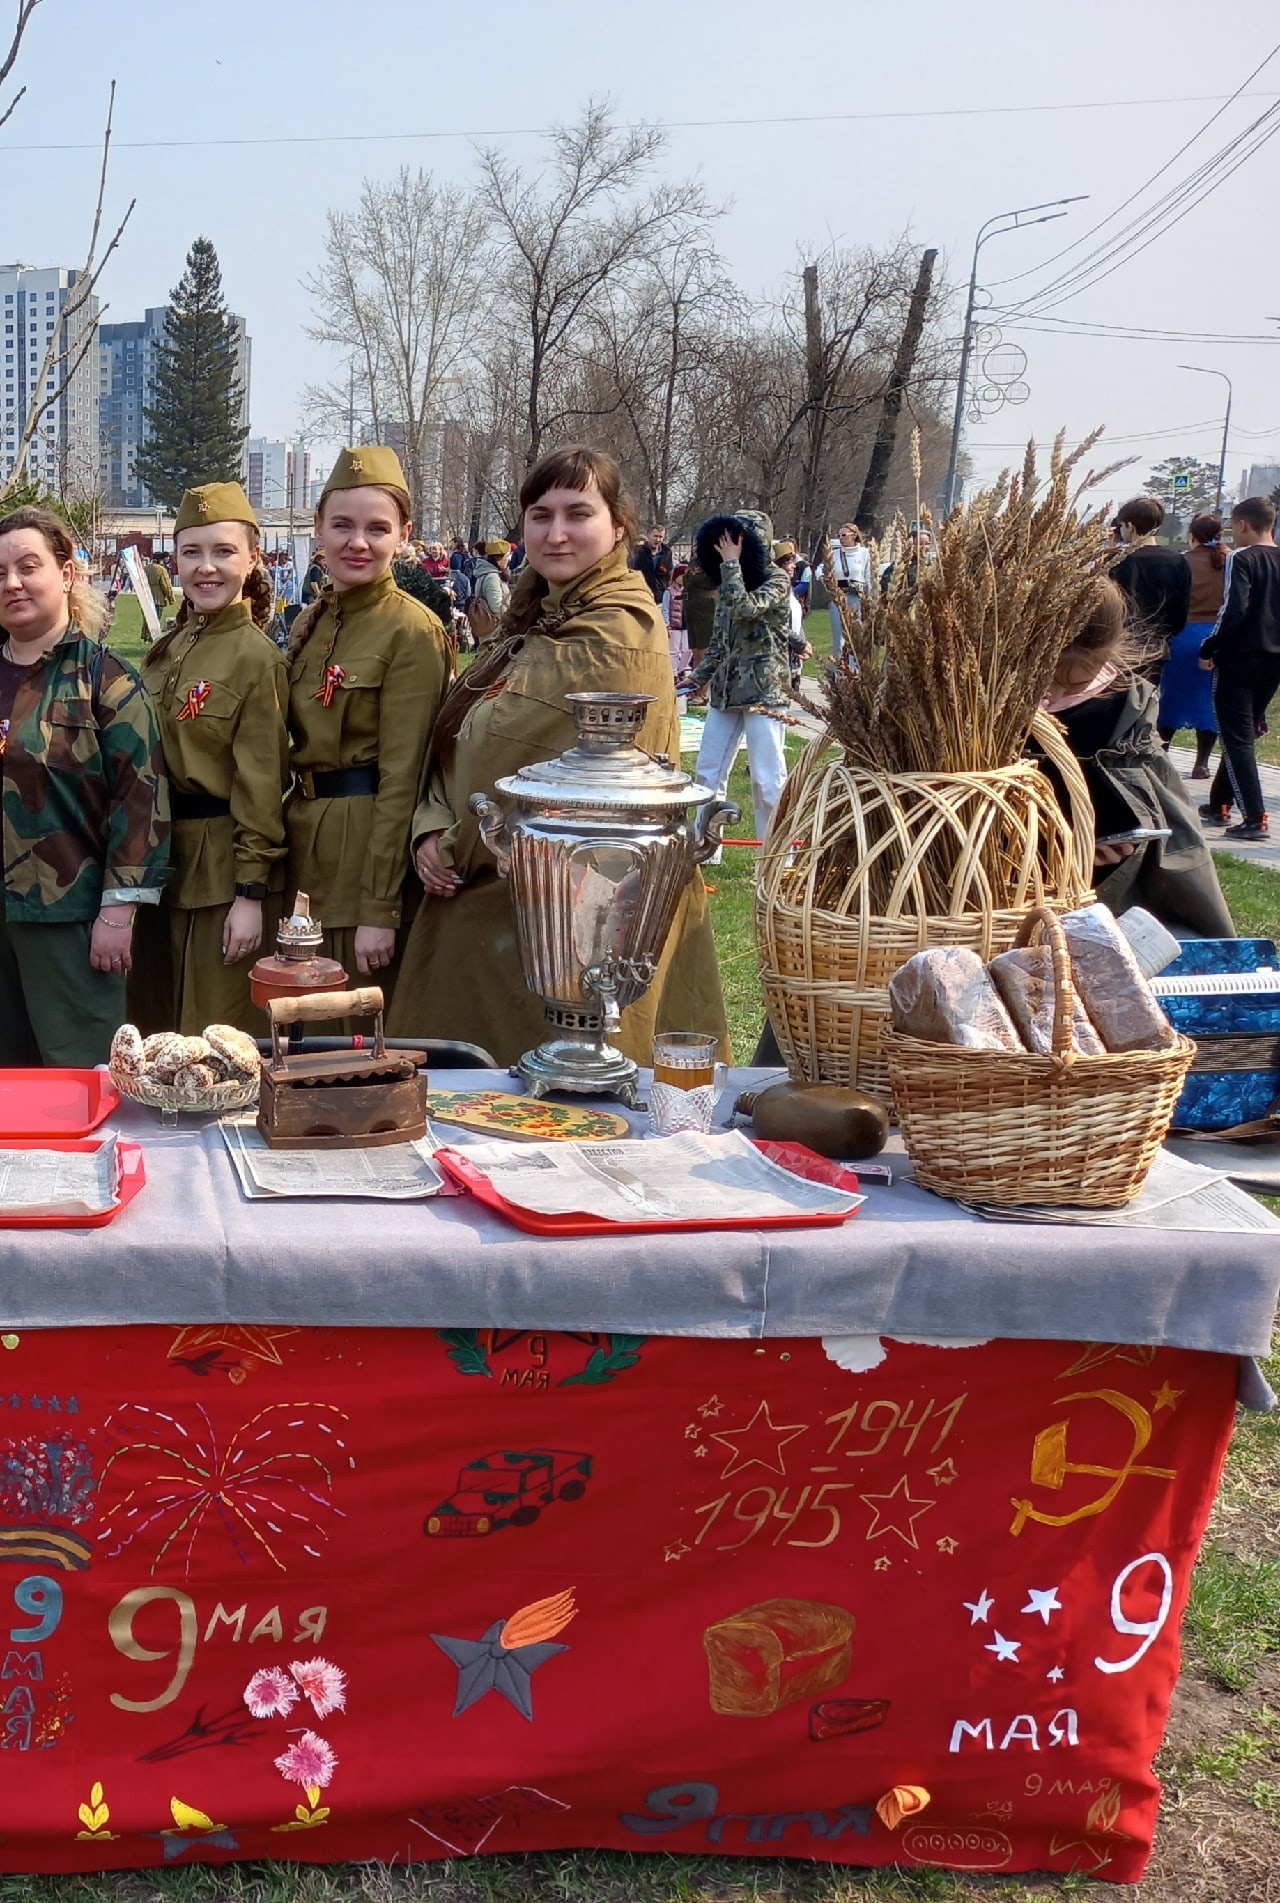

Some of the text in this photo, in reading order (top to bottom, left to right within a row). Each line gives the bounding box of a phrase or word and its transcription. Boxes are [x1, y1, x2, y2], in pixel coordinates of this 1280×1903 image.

[499, 1367, 551, 1391] МАЯ
[527, 1334, 549, 1369] 9
[824, 1391, 969, 1457] 1941
[694, 1483, 856, 1551] 1945
[9, 1575, 64, 1643] 9
[1094, 1551, 1174, 1674] 9
[107, 1585, 328, 1713] 9 МАЯ
[948, 1707, 1081, 1754] МАЯ
[1023, 1773, 1112, 1797] 9 МАЯ
